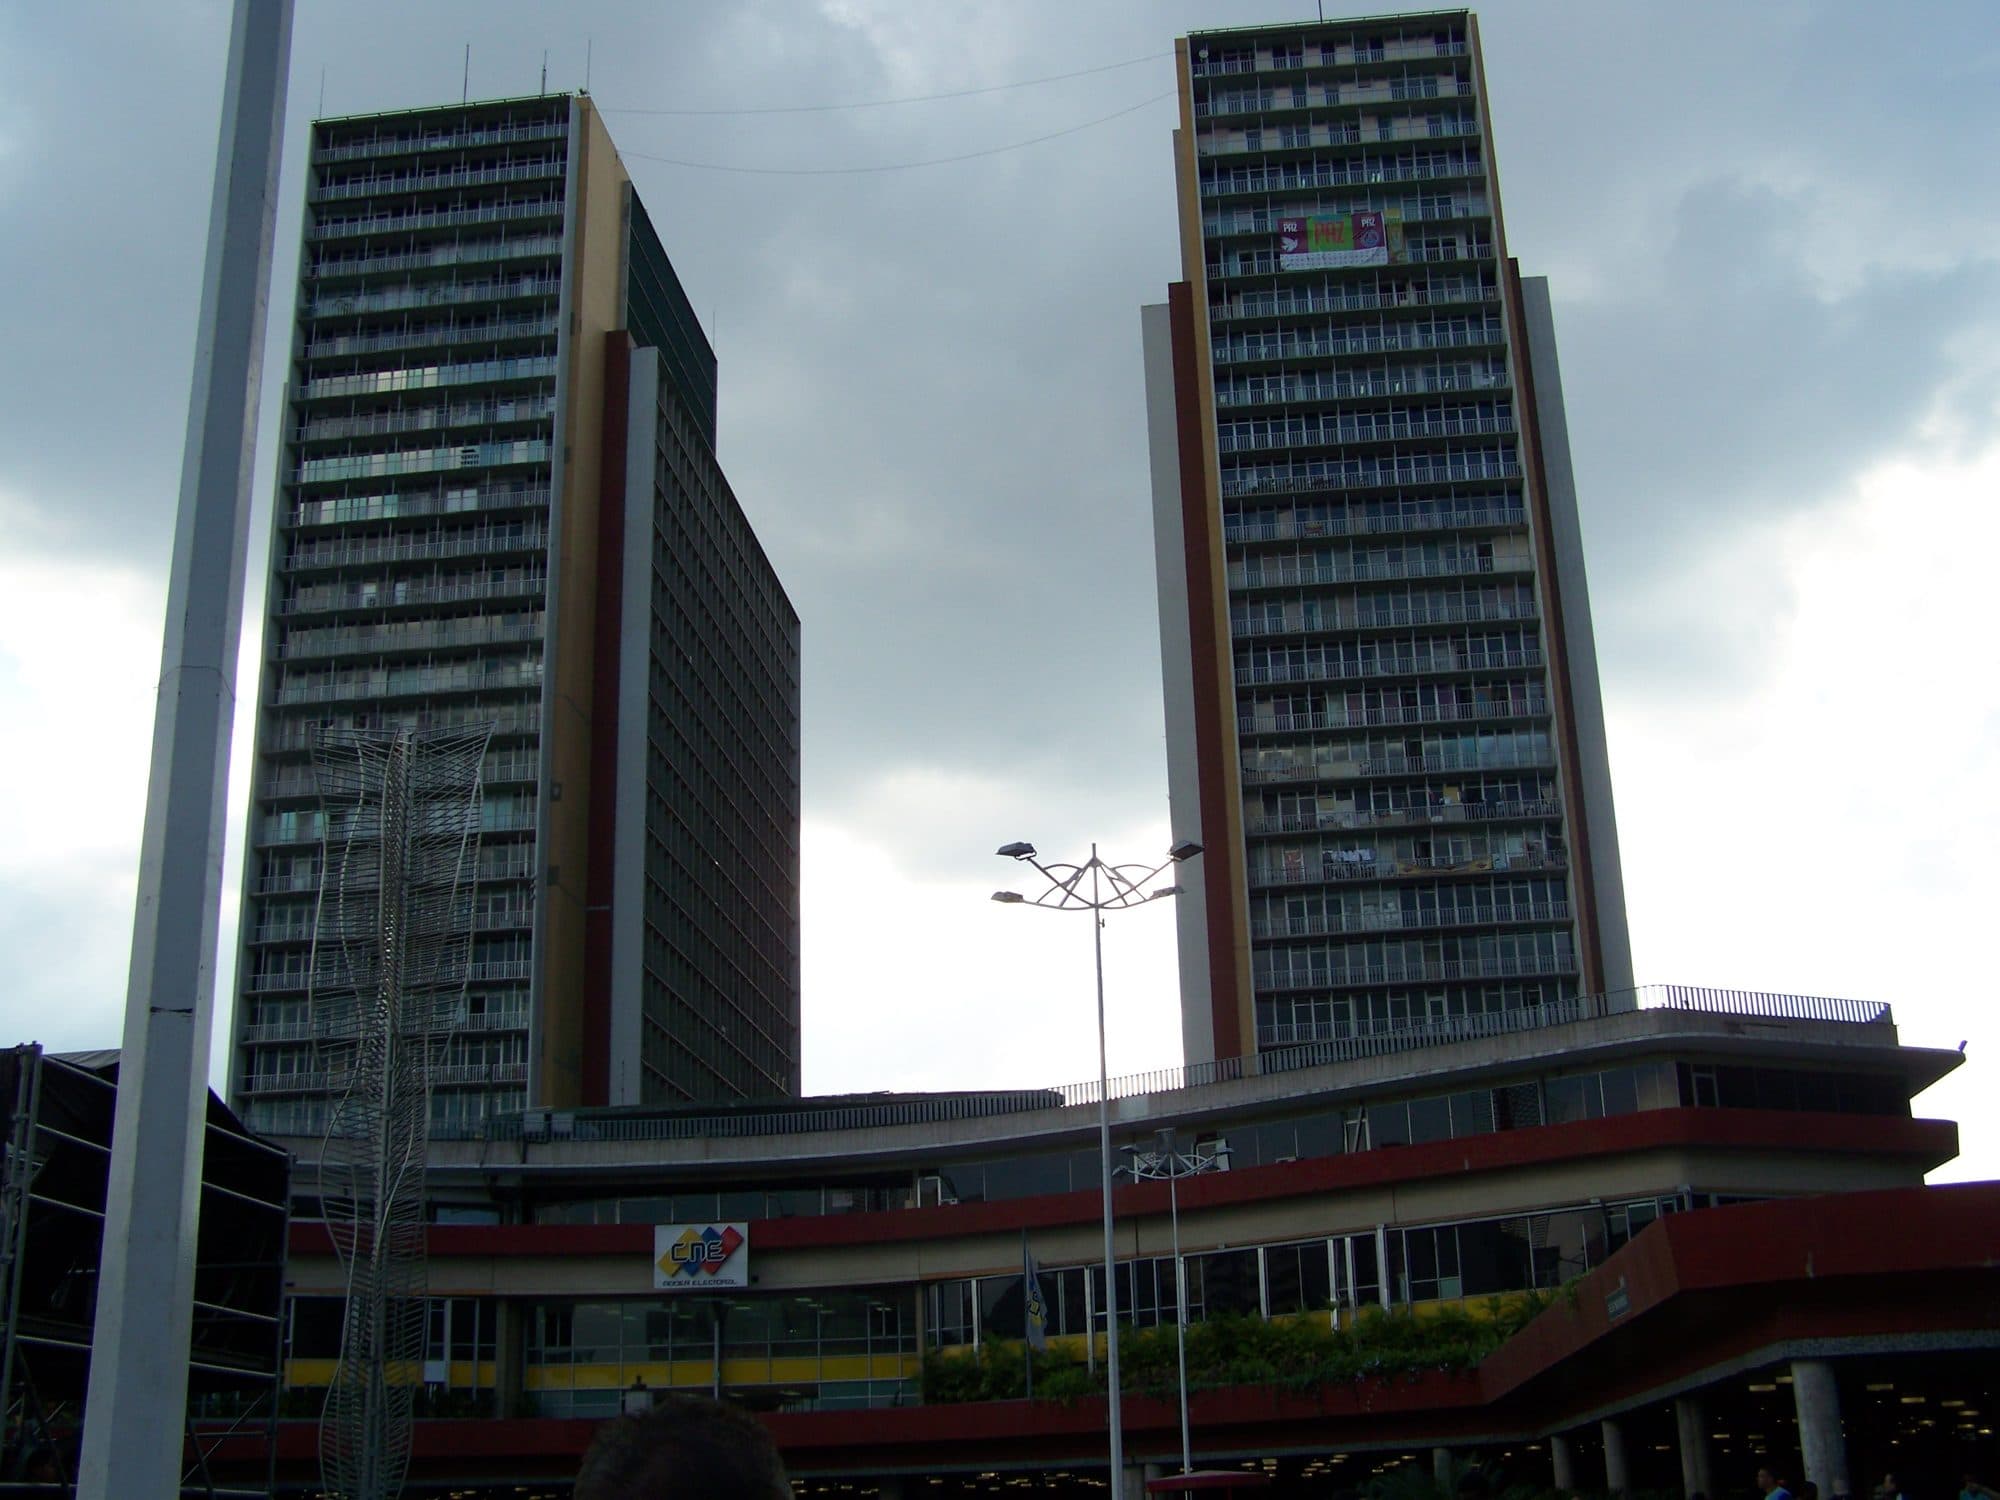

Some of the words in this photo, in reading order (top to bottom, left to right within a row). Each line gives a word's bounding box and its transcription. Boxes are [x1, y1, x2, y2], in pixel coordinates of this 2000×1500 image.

[1283, 223, 1297, 232] PAZ
[1361, 218, 1375, 227] PAZ
[1314, 222, 1344, 245] PAZ
[671, 1240, 726, 1263] CNE
